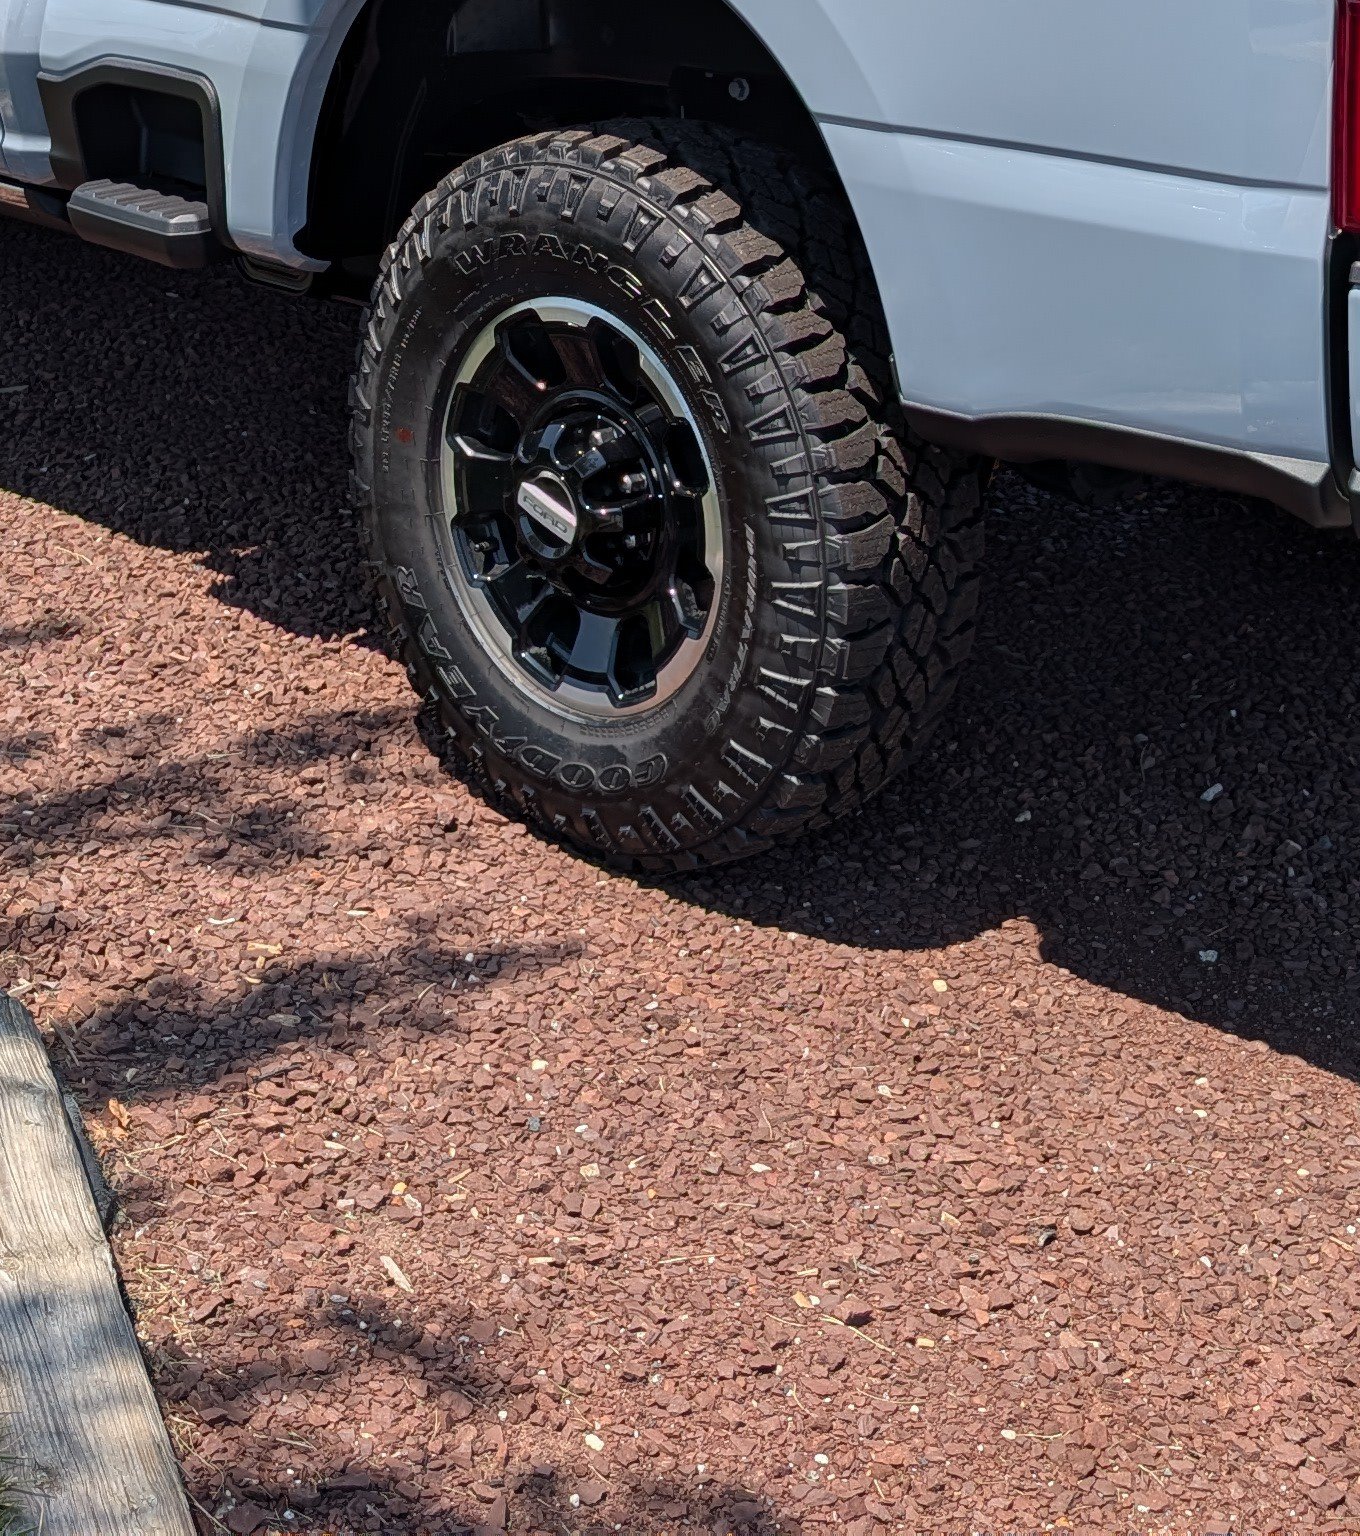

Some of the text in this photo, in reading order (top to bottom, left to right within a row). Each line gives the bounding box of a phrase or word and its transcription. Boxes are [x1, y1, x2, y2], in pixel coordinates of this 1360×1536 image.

[452, 232, 731, 435] WRANGLER
[522, 495, 568, 534] FORD
[396, 564, 669, 793] GOODYEAR
